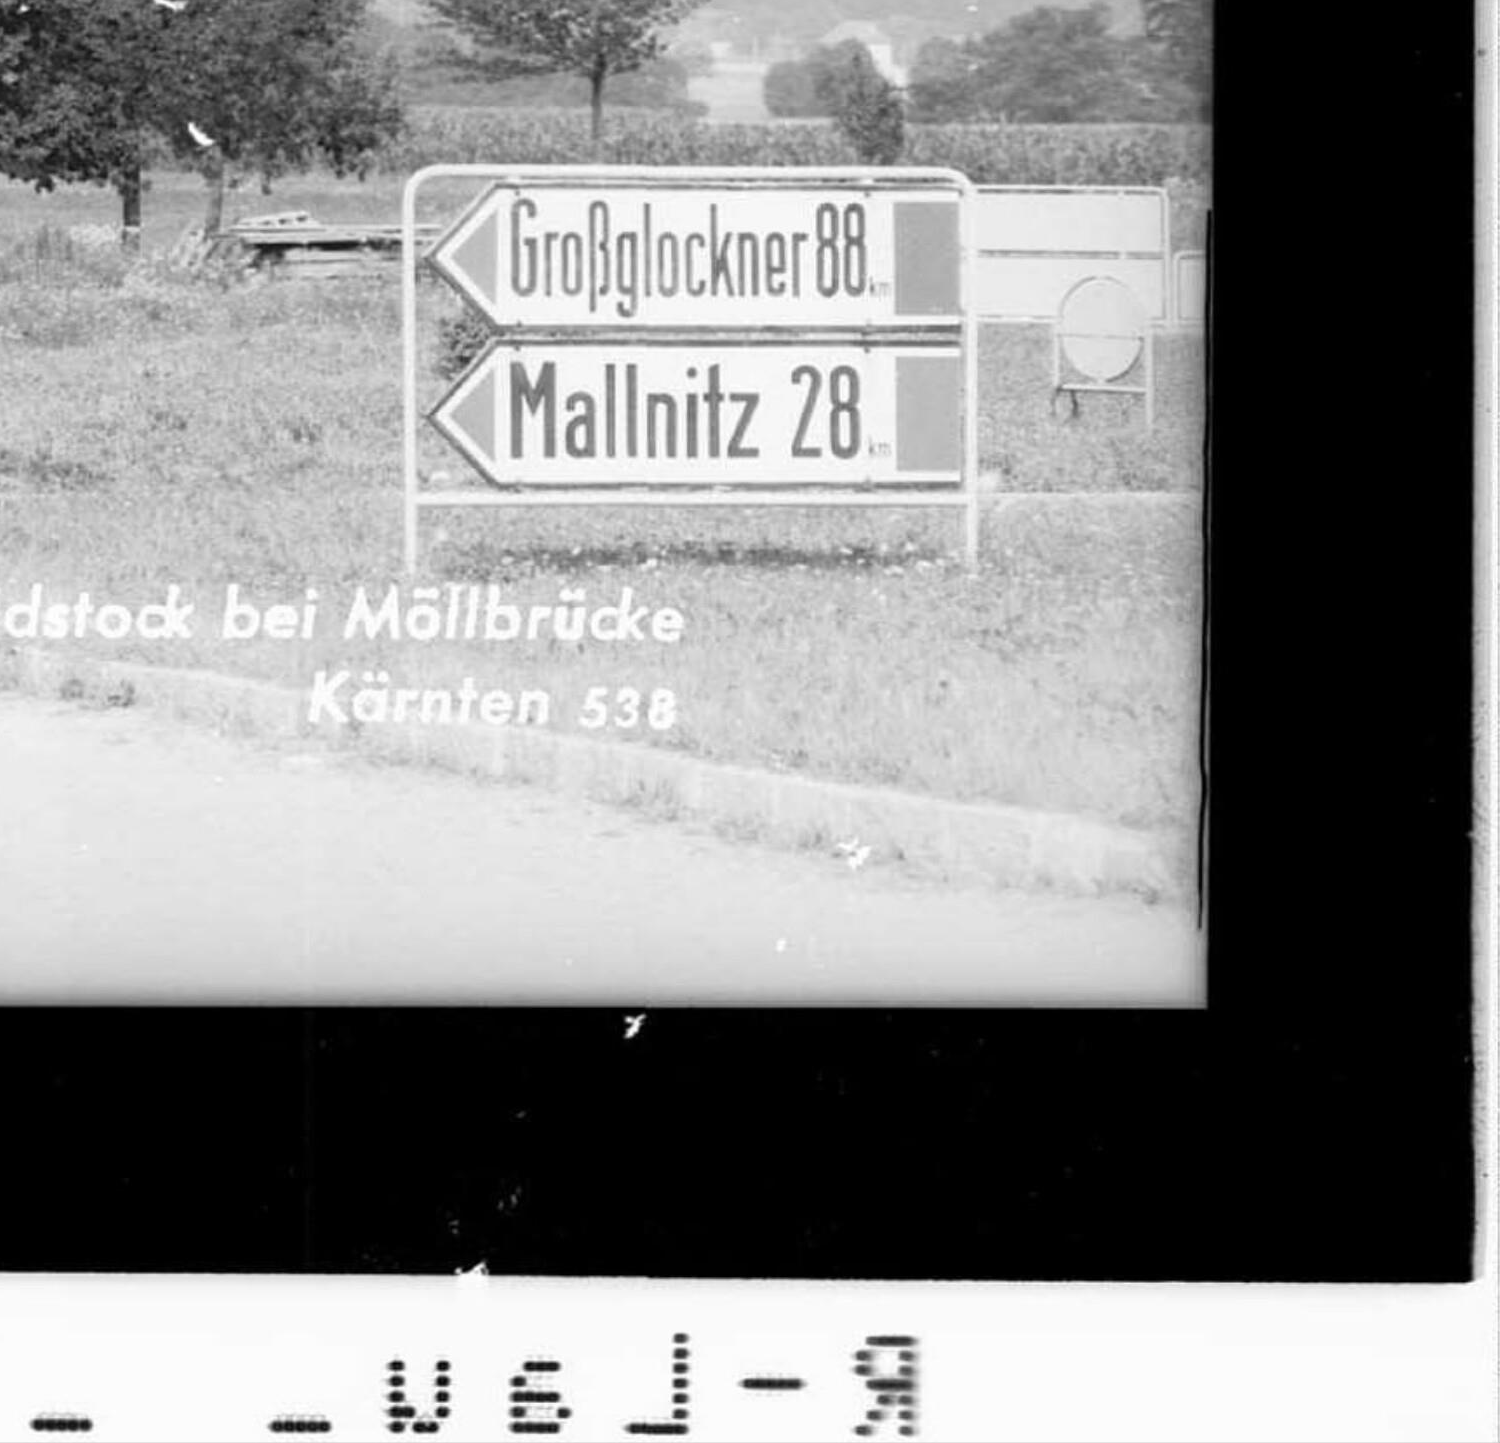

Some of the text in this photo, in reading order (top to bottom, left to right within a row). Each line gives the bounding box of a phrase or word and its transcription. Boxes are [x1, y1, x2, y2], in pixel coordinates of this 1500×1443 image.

[510, 199, 809, 318] Großglockner
[815, 202, 867, 298] 88
[510, 361, 760, 459] Mallnitz
[791, 364, 861, 460] 28
